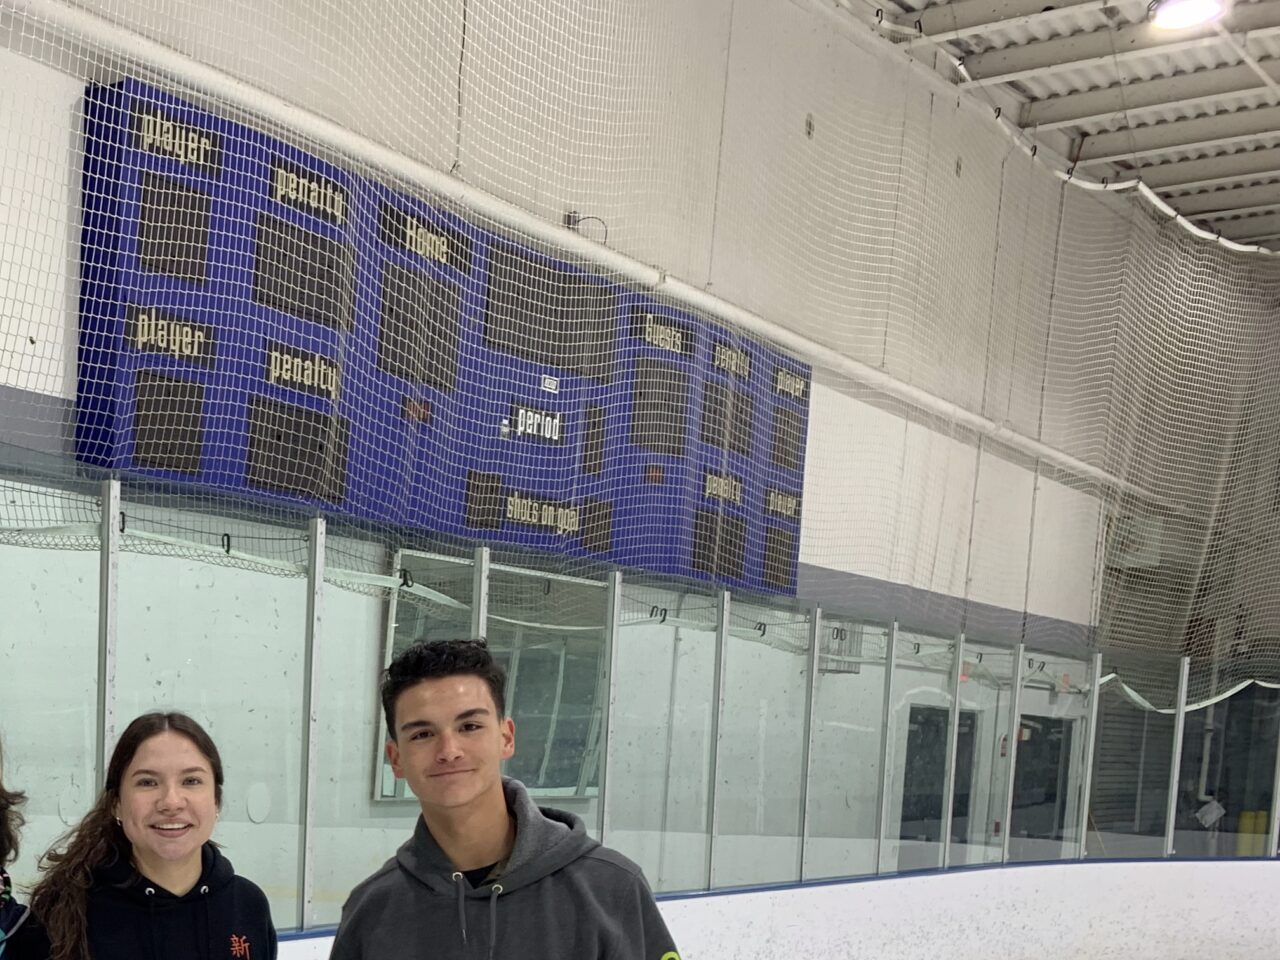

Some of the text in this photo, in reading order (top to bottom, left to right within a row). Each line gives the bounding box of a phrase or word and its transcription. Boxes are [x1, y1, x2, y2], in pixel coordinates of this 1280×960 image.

[142, 110, 211, 164] player
[276, 167, 345, 224] penalty
[406, 216, 448, 263] Home
[137, 308, 205, 359] player
[270, 350, 338, 400] penalty
[517, 409, 561, 440] period
[506, 491, 539, 523] shots
[541, 504, 555, 526] on
